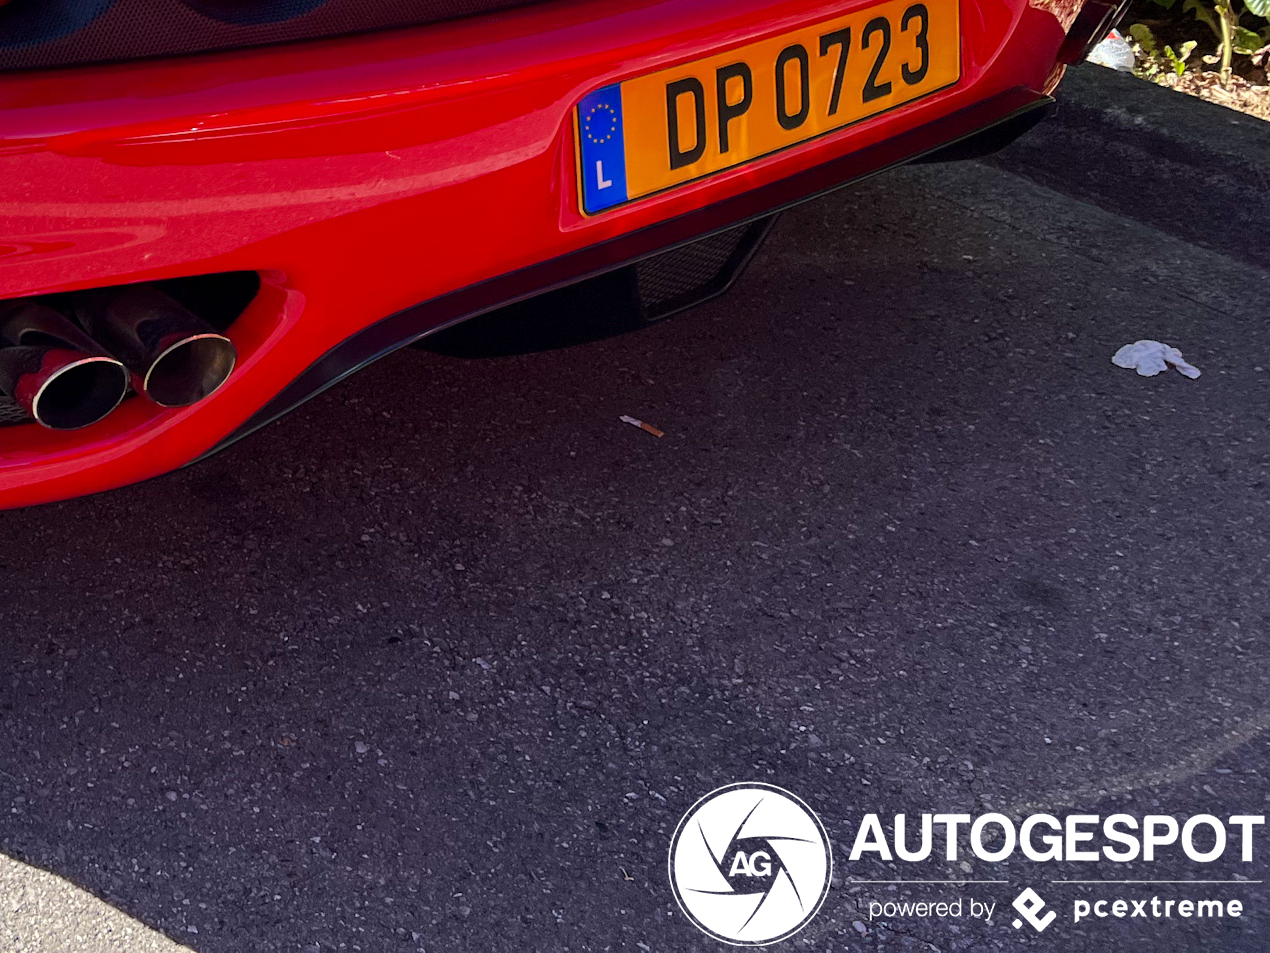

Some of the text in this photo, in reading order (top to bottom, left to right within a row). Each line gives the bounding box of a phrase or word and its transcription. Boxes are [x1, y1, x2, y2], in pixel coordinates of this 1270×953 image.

[666, 3, 929, 170] DP 0723
[596, 160, 612, 190] L
